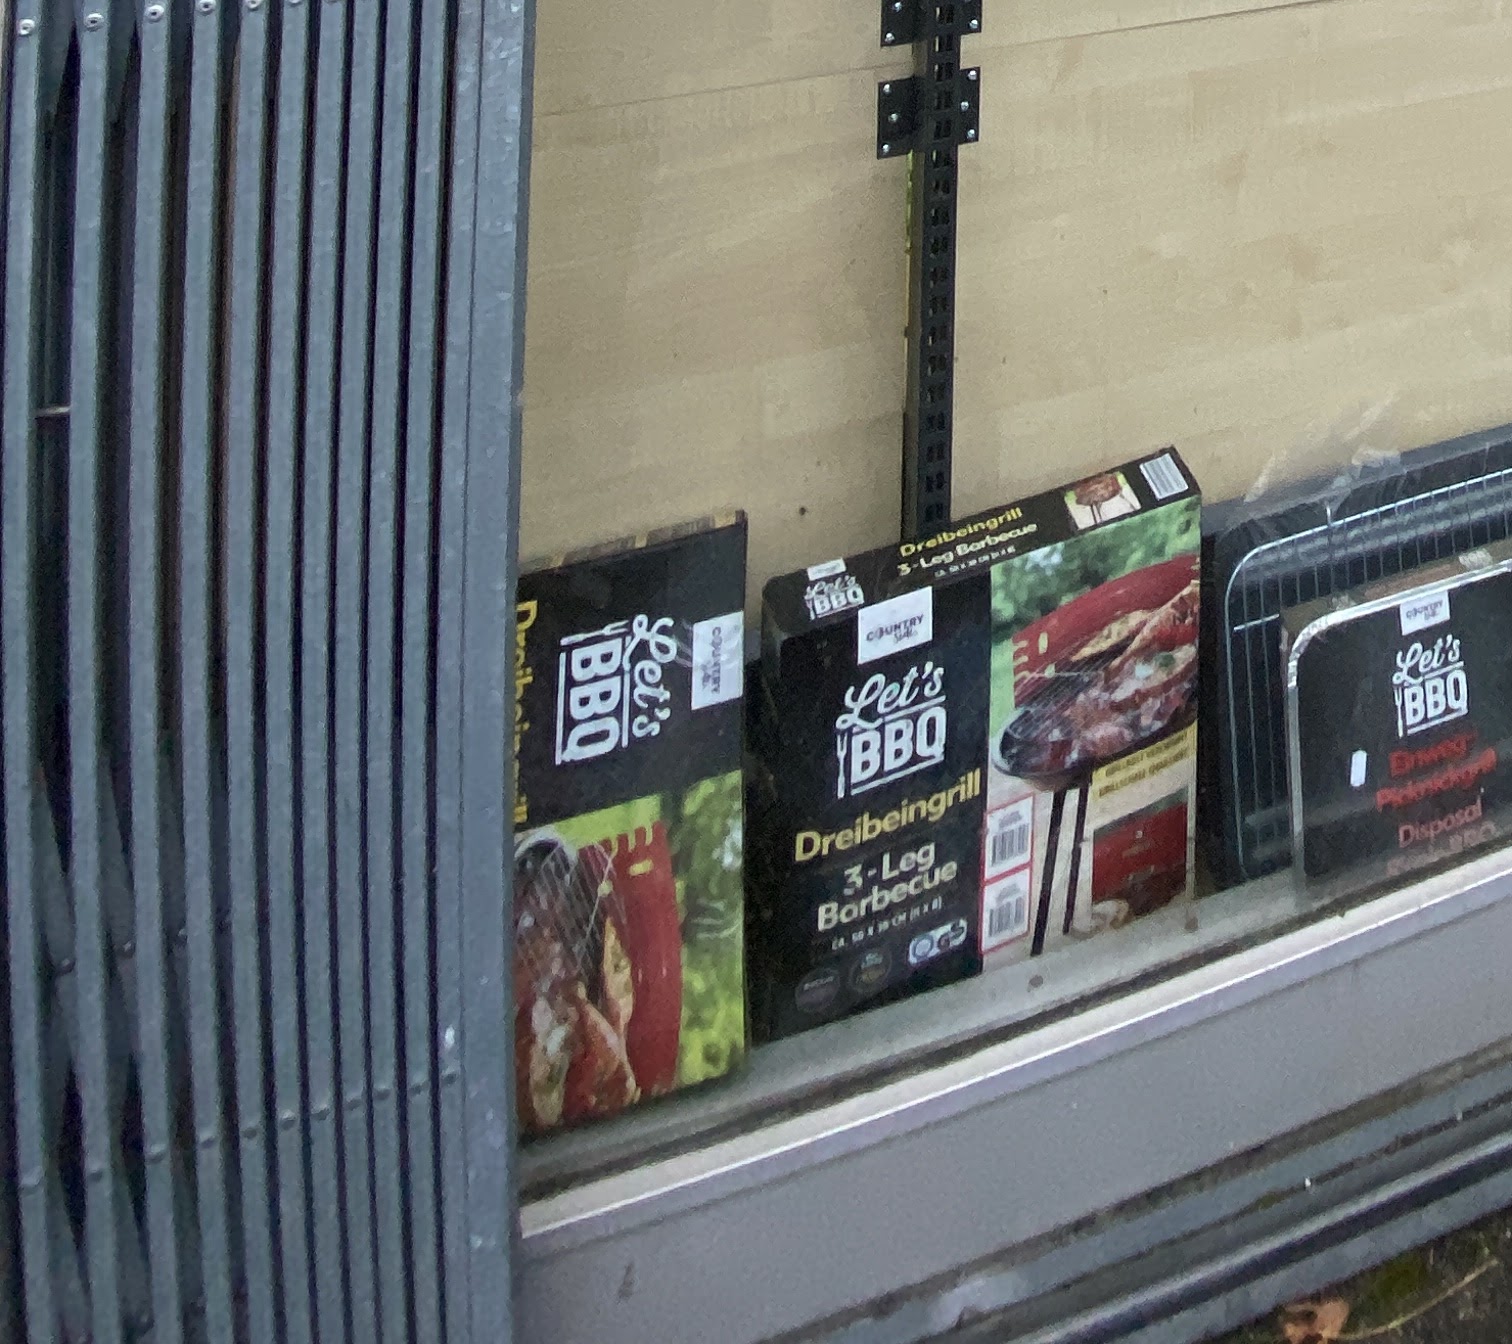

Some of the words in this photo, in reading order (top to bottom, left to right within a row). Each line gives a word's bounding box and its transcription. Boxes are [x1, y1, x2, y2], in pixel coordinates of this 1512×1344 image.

[813, 583, 865, 615] BBQ
[623, 613, 678, 739] Let's
[1391, 633, 1461, 685] Let's
[561, 636, 623, 762] BBQ
[835, 661, 945, 731] Let's
[1404, 669, 1468, 726] BBQ
[850, 706, 948, 784] BBQ
[795, 766, 982, 863] Dreibeingrill
[817, 860, 958, 932] Barbecue
